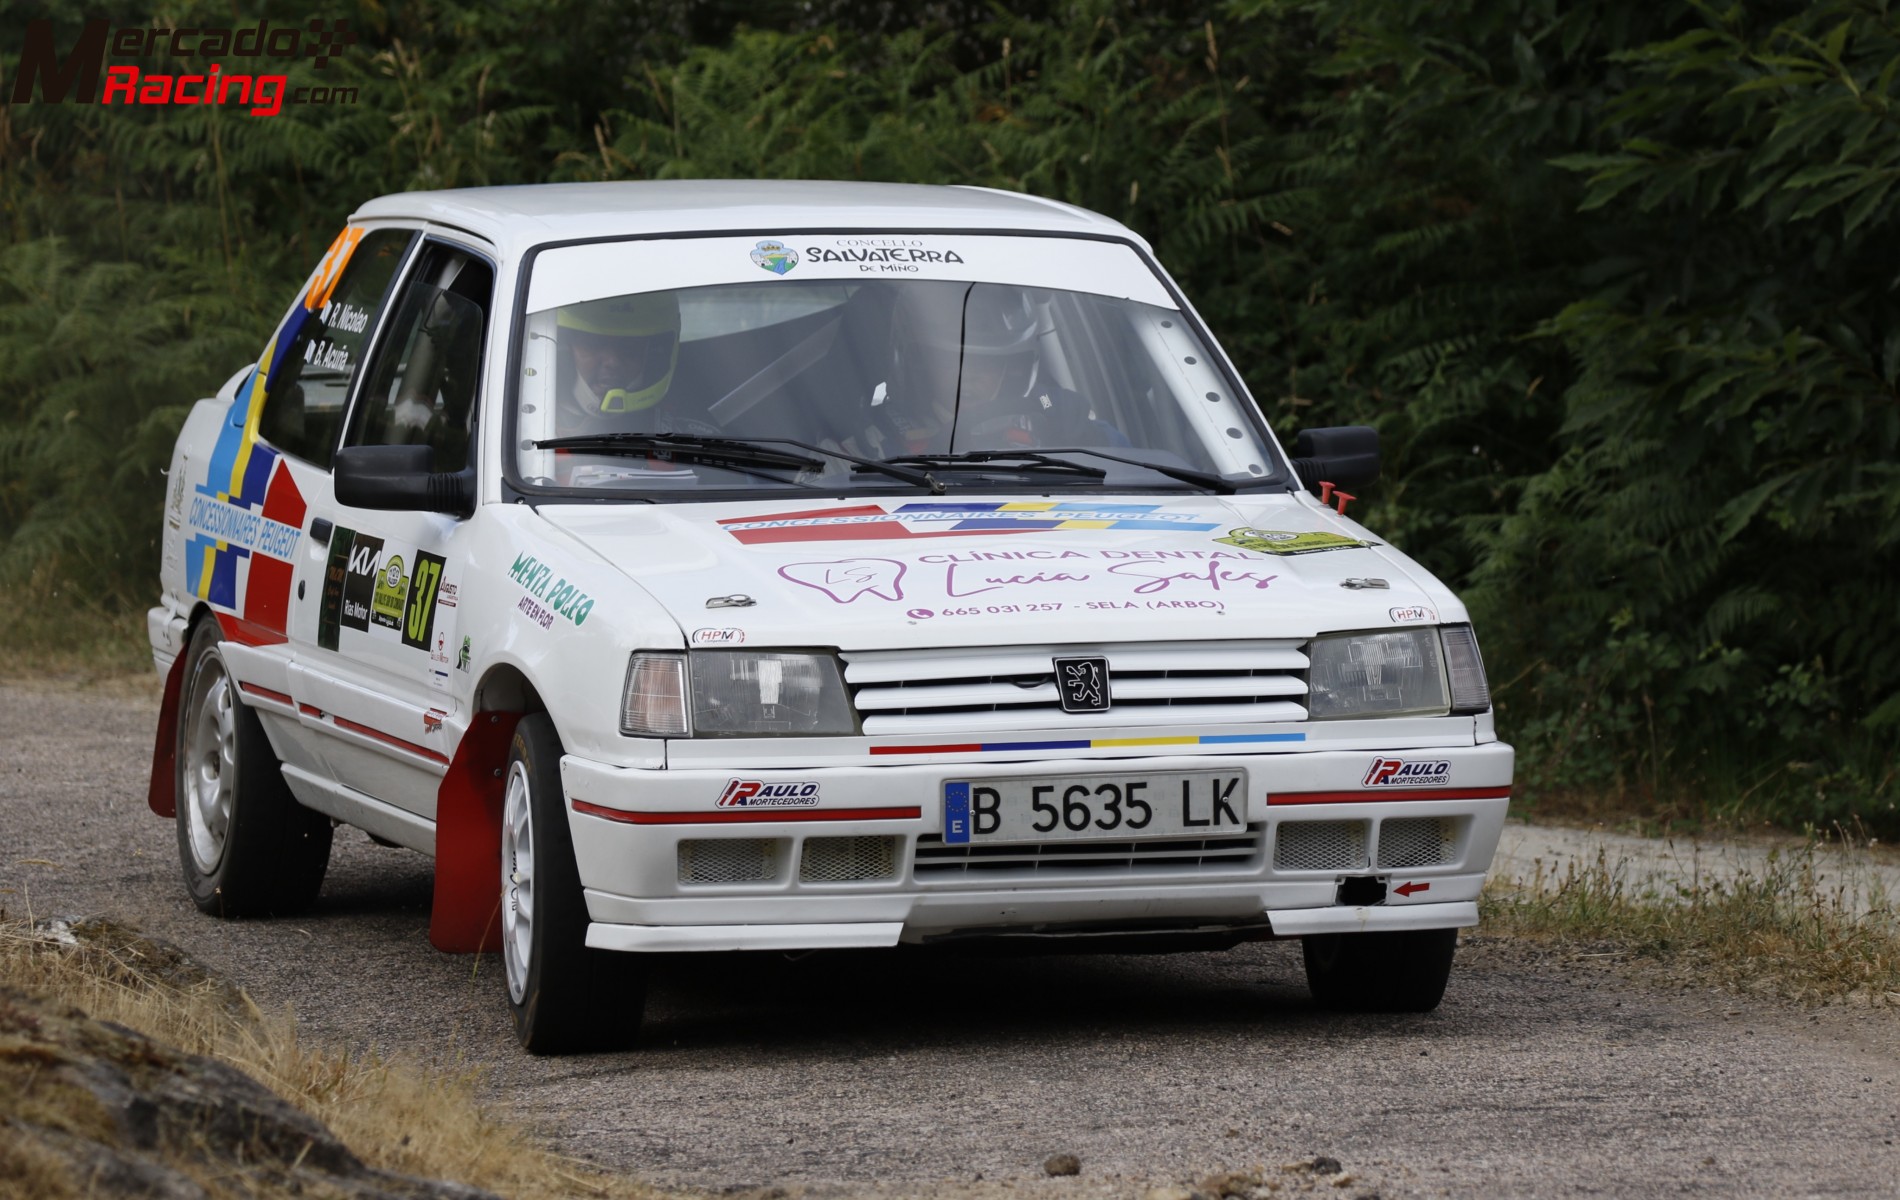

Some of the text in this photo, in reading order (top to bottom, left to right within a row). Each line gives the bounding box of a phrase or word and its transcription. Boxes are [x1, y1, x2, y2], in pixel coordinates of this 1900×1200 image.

[836, 239, 923, 247] CONCELLO
[806, 247, 964, 264] SALVATERRA
[337, 303, 369, 334] Nicolao
[189, 497, 302, 560] CONCESSIONNAIRES PEUGEOT
[721, 511, 1201, 531] CONCESSIONNAIRES PEUGEOT
[1099, 550, 1265, 561] DENTAL
[508, 550, 595, 626] MENTA POLEO
[408, 558, 441, 642] 37
[942, 607, 981, 617] 665
[986, 604, 1021, 614] 031
[1026, 602, 1063, 612] 257
[1086, 601, 1139, 610] SELA
[1146, 600, 1226, 611] (ARBO)
[354, 602, 368, 620] Motor
[518, 595, 555, 631] ARTE EN FLOR
[1396, 608, 1425, 620] HPM
[700, 630, 735, 640] HPM
[973, 777, 1241, 835] B 5635 LK
[951, 819, 963, 834] E
